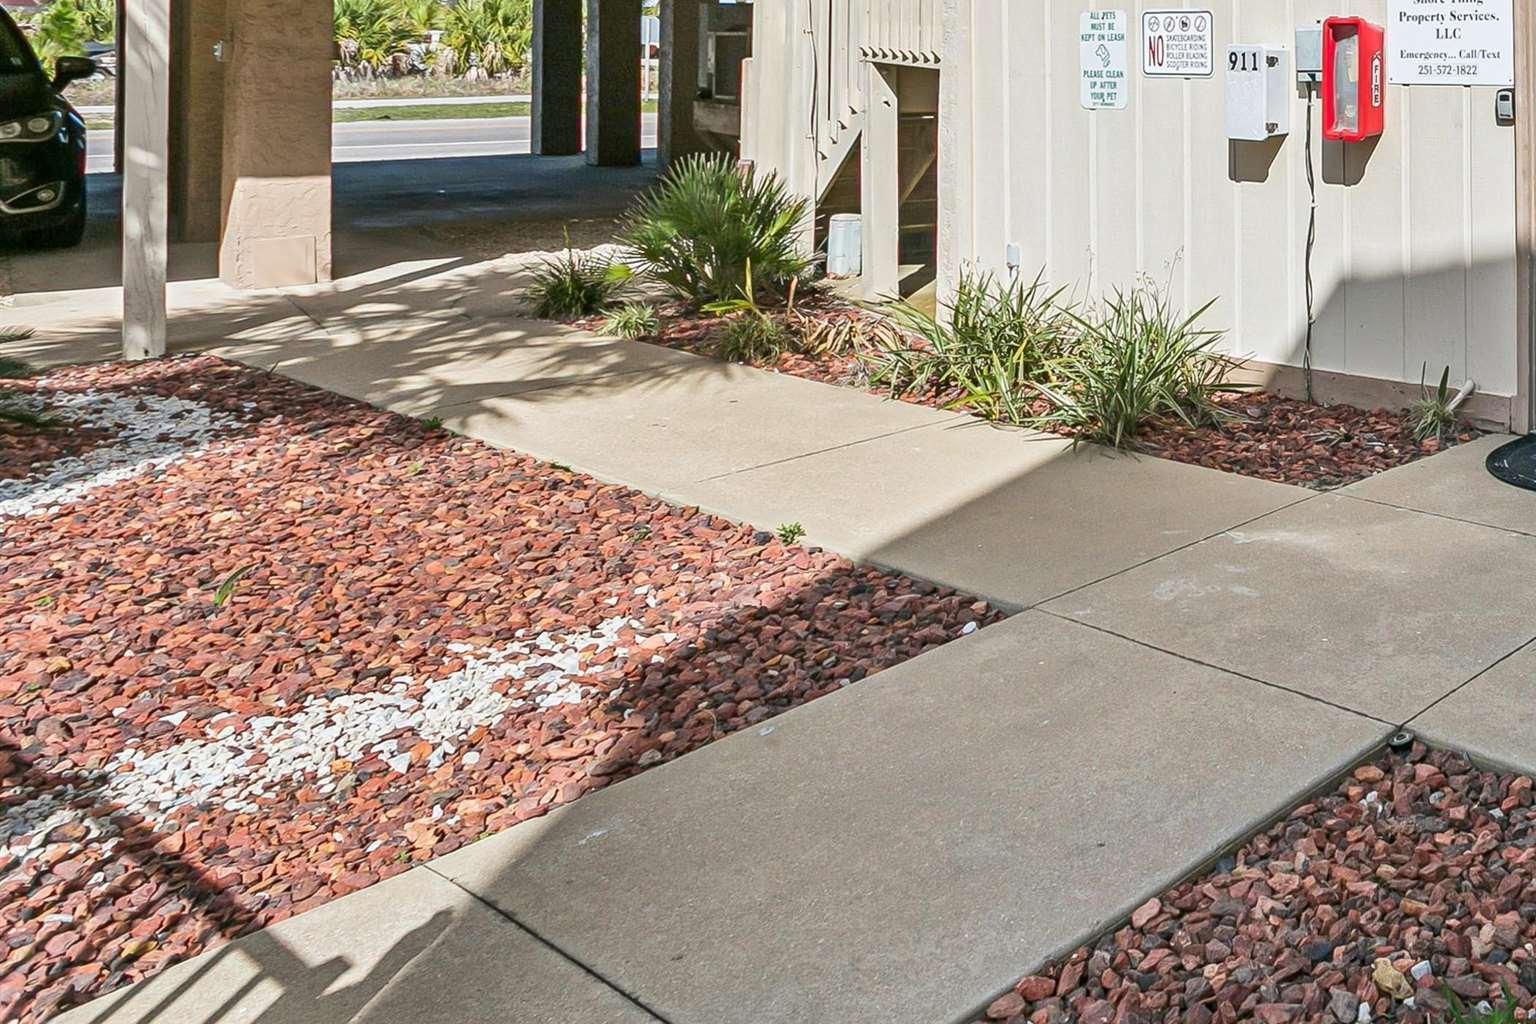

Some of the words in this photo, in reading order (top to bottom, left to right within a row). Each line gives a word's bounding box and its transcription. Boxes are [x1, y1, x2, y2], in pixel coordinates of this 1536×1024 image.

[1399, 12, 1446, 25] Property
[1107, 33, 1125, 42] LEASH
[1436, 28, 1462, 40] LLC
[1148, 35, 1164, 67] NO
[1229, 52, 1258, 71] 911
[1418, 65, 1478, 75] 251-572-1822
[1107, 92, 1117, 100] PET
